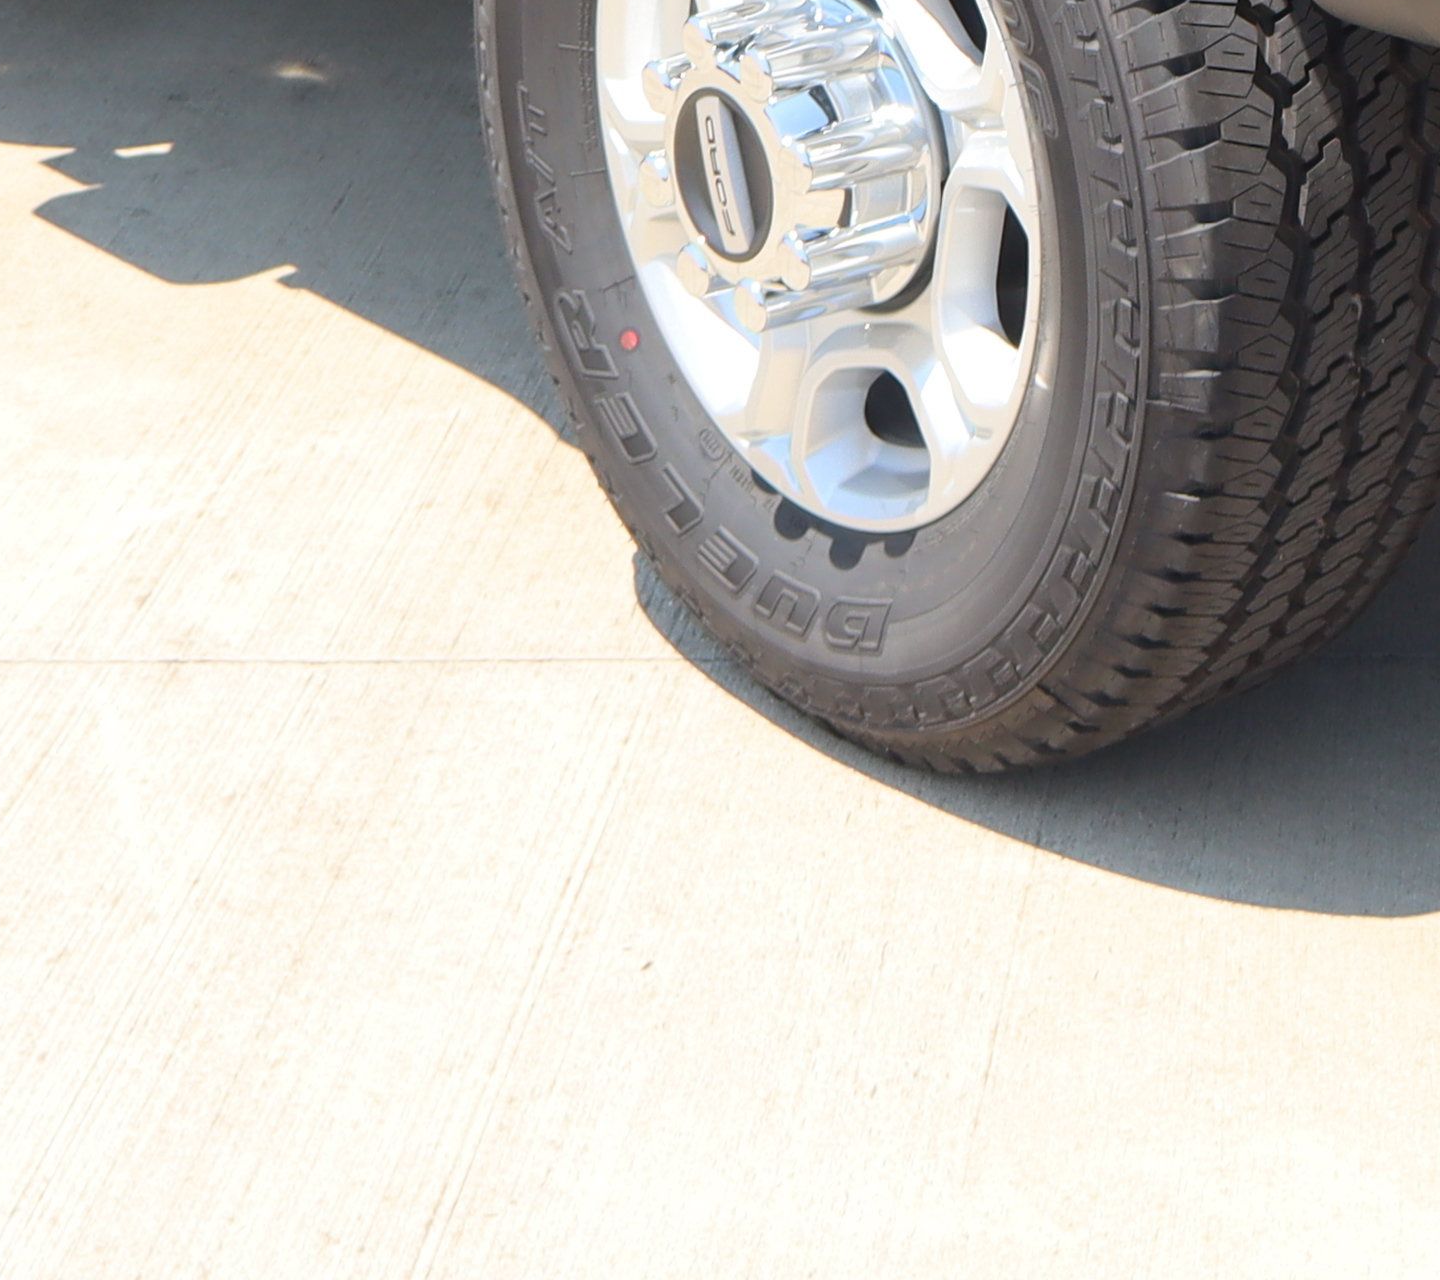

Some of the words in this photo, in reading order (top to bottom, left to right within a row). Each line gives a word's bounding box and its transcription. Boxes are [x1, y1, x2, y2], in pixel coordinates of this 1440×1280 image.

[516, 85, 573, 256] A/T
[705, 115, 736, 237] FORD
[558, 287, 893, 655] DUELER
